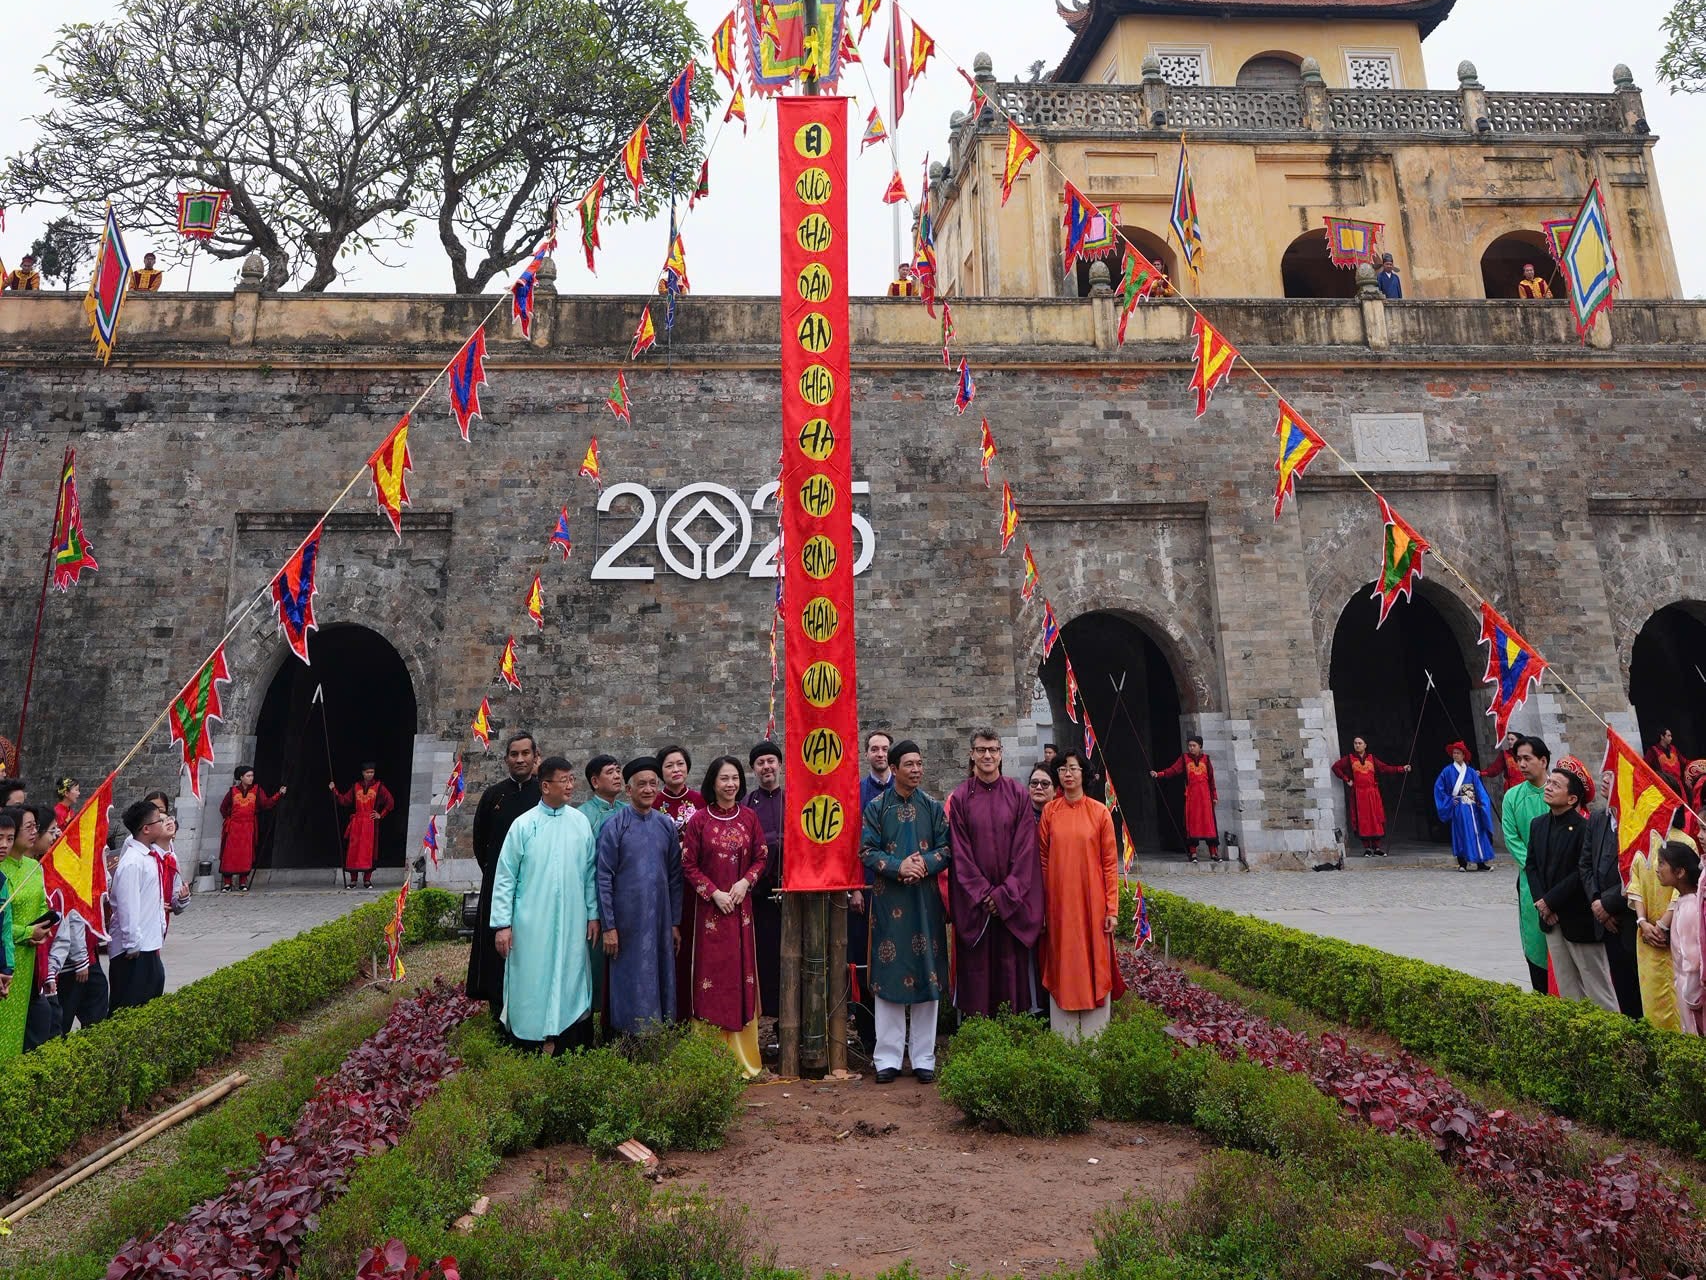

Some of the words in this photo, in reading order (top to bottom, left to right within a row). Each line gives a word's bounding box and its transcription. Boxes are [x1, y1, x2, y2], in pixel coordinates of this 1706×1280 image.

[799, 217, 831, 251] THÁI
[800, 265, 830, 299] DÂN
[799, 314, 831, 351] AN
[802, 367, 832, 403] THIÊN
[799, 421, 834, 458] HẠ
[801, 478, 834, 515] THÁI
[803, 537, 837, 577] BÌNH
[803, 600, 838, 640] THÁNH
[802, 664, 841, 702] CUNG
[803, 730, 841, 774] VẠN
[802, 798, 841, 841] TUẾ
